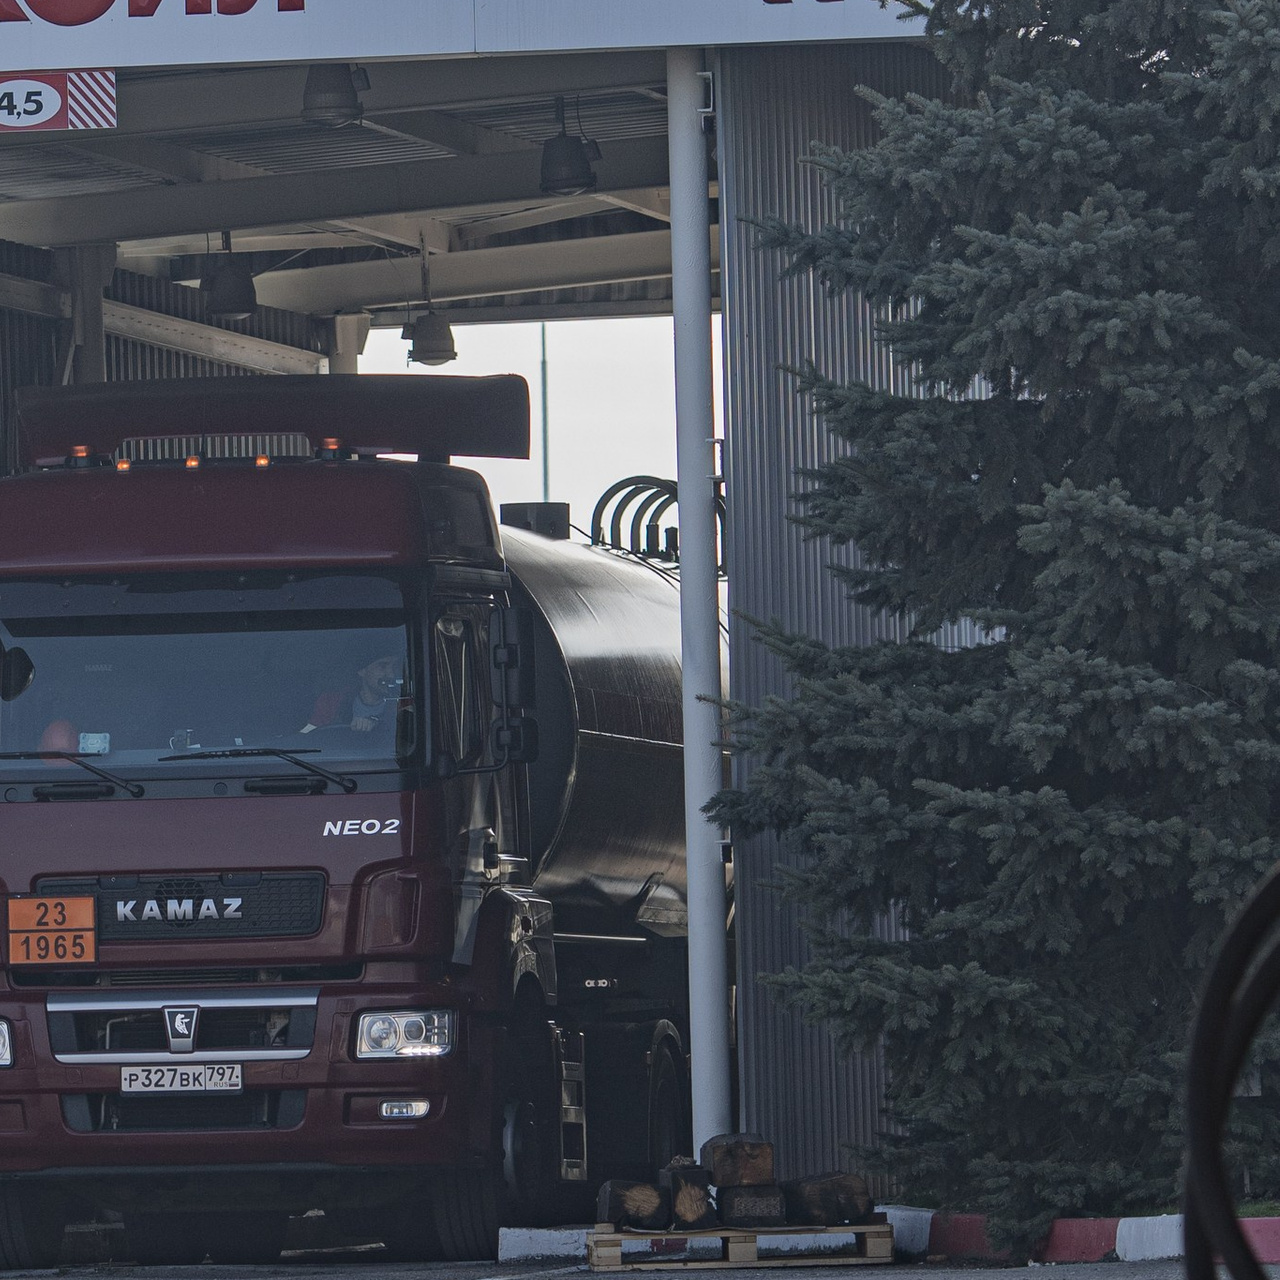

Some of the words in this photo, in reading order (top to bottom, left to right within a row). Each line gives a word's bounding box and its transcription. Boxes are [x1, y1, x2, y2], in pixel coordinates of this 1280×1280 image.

[322, 819, 400, 836] NEO2
[36, 902, 66, 926] 23
[116, 898, 242, 921] KAMAZ
[21, 934, 85, 960] 1965
[206, 1066, 236, 1081] 797
